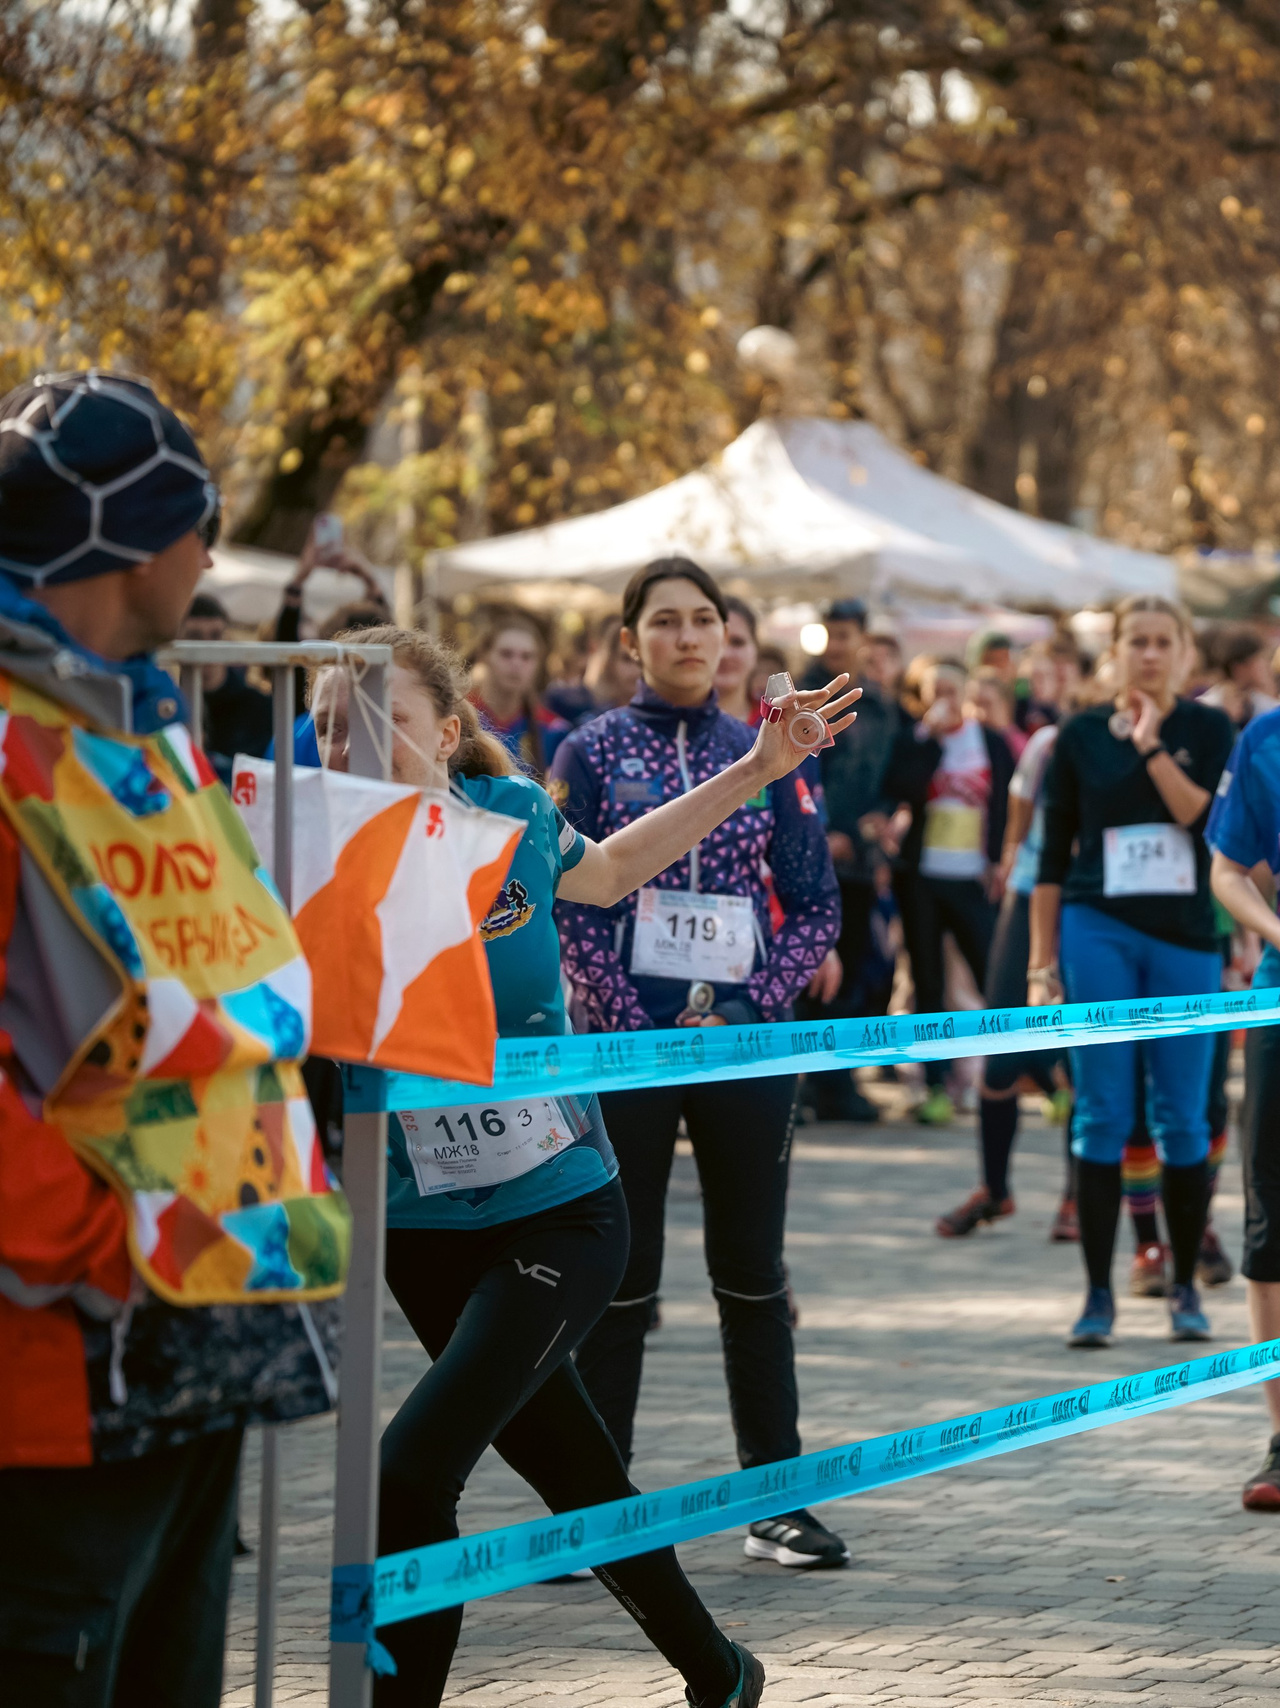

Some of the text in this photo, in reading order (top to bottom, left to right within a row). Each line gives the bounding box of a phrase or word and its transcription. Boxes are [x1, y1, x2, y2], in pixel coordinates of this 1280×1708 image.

[667, 913, 716, 941] 119
[726, 930, 736, 947] 3
[434, 1109, 505, 1142] 116
[517, 1108, 533, 1126] 3
[434, 1144, 479, 1160] МЖ18
[600, 1565, 647, 1620] TORY CODE
